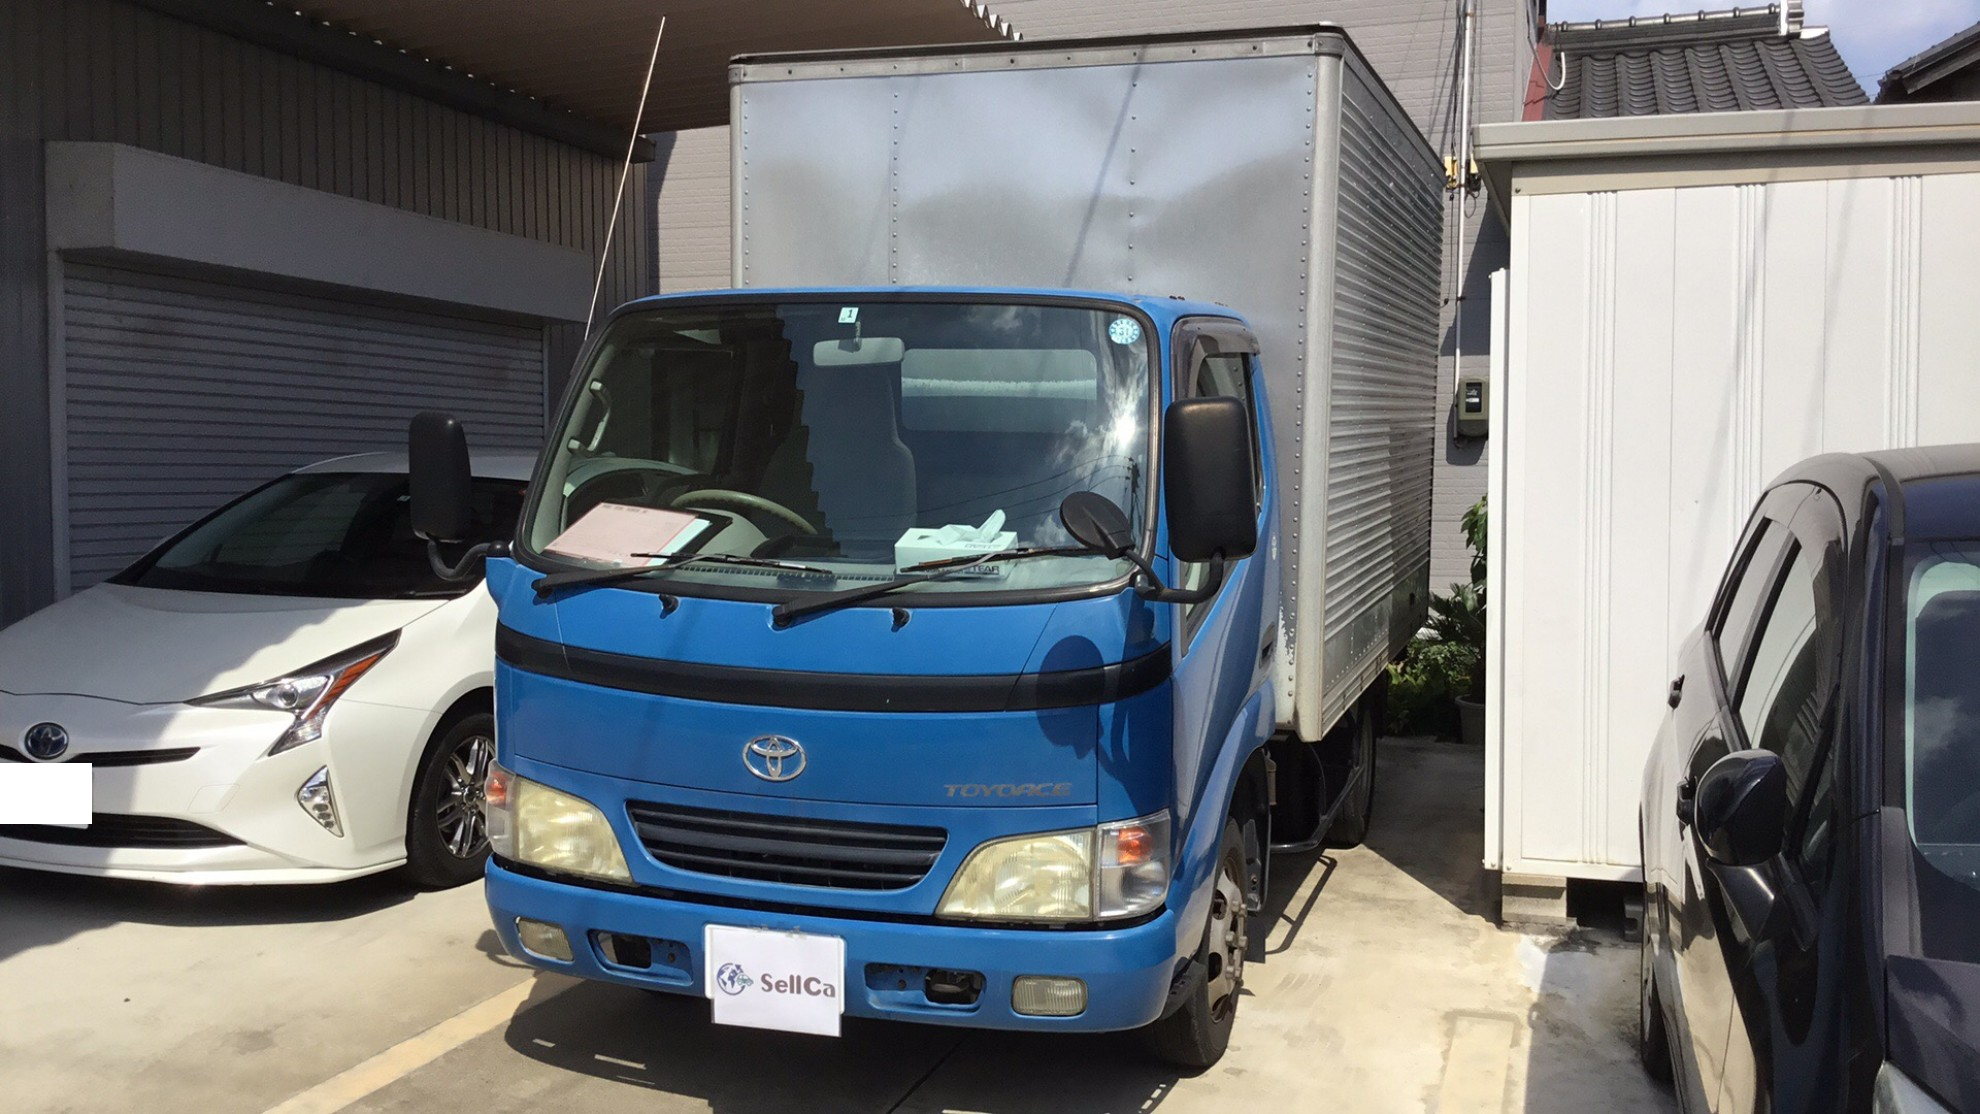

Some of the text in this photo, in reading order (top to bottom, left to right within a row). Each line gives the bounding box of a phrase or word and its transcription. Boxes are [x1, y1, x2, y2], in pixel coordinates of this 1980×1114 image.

[847, 309, 853, 318] 1
[944, 782, 1072, 797] TOYOACE
[760, 973, 836, 998] SellCa
